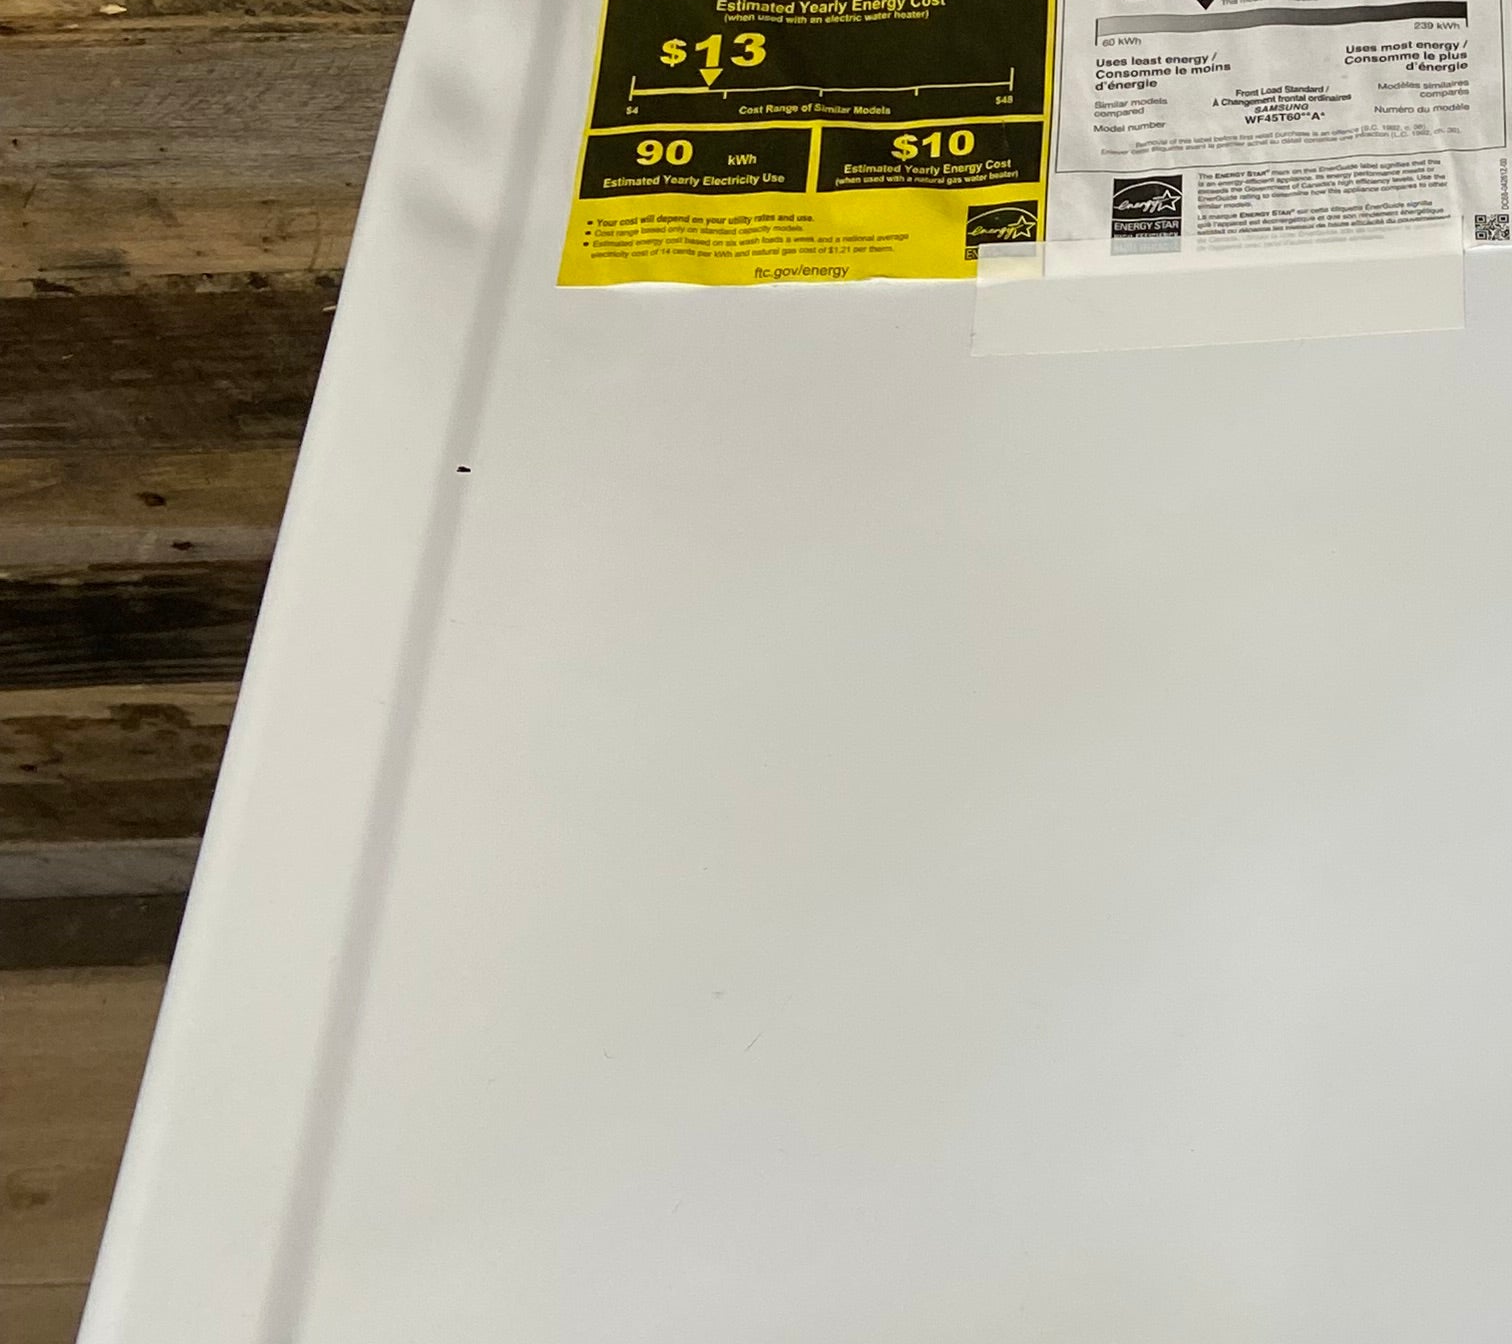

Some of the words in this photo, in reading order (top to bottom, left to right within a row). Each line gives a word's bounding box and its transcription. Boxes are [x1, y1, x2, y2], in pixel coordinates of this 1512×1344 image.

[716, 0, 794, 14] Estimated
[800, 0, 847, 14] Yearly
[724, 14, 755, 23] (when
[758, 14, 783, 23] used
[786, 15, 807, 24] with
[810, 16, 822, 24] an
[825, 13, 862, 23] electric
[864, 12, 891, 21] water
[894, 10, 929, 19] heater)
[1414, 22, 1434, 30] 239
[1437, 22, 1460, 30] kWh
[1102, 38, 1115, 47] 60
[1118, 37, 1141, 45] kWh
[1346, 45, 1377, 54] Uses
[1381, 41, 1413, 52] most
[1416, 41, 1459, 51] energy
[660, 33, 767, 67] $13
[1096, 58, 1127, 67] Uses
[1131, 56, 1162, 65] least
[1165, 55, 1208, 66] energy
[1344, 53, 1420, 65] Consomme
[1423, 51, 1435, 61] le
[1439, 51, 1467, 62] plus
[1095, 68, 1171, 79] Consomme
[1175, 66, 1187, 75] le
[1191, 63, 1231, 74] moins
[1423, 80, 1469, 89] similaires
[1235, 89, 1259, 97] Front
[1261, 87, 1282, 95] Load
[1285, 85, 1324, 93] Standard
[739, 104, 763, 115] Cost
[766, 104, 798, 115] Range
[801, 103, 812, 112] of
[815, 104, 851, 114] Similar
[853, 106, 891, 115] Models
[1094, 99, 1128, 108] Similar
[1131, 98, 1168, 107] models
[1254, 104, 1309, 113] SAMSUNG
[626, 106, 639, 115] $4
[1094, 108, 1144, 118] compared
[1128, 122, 1166, 131] number
[891, 130, 975, 162] $10
[636, 139, 694, 166] 90
[728, 154, 757, 166] kWh
[844, 164, 901, 174] Estimated
[904, 164, 940, 176] Yearly
[943, 162, 982, 174] Energy
[986, 159, 1012, 169] Cost
[603, 175, 660, 189] Estimated
[663, 174, 700, 188] Yearly
[702, 174, 760, 186] Electricity
[762, 173, 785, 183] Use
[1114, 221, 1153, 231] ENERGY
[1154, 220, 1179, 230] STAR
[755, 264, 849, 279] ftc.gov/energy
